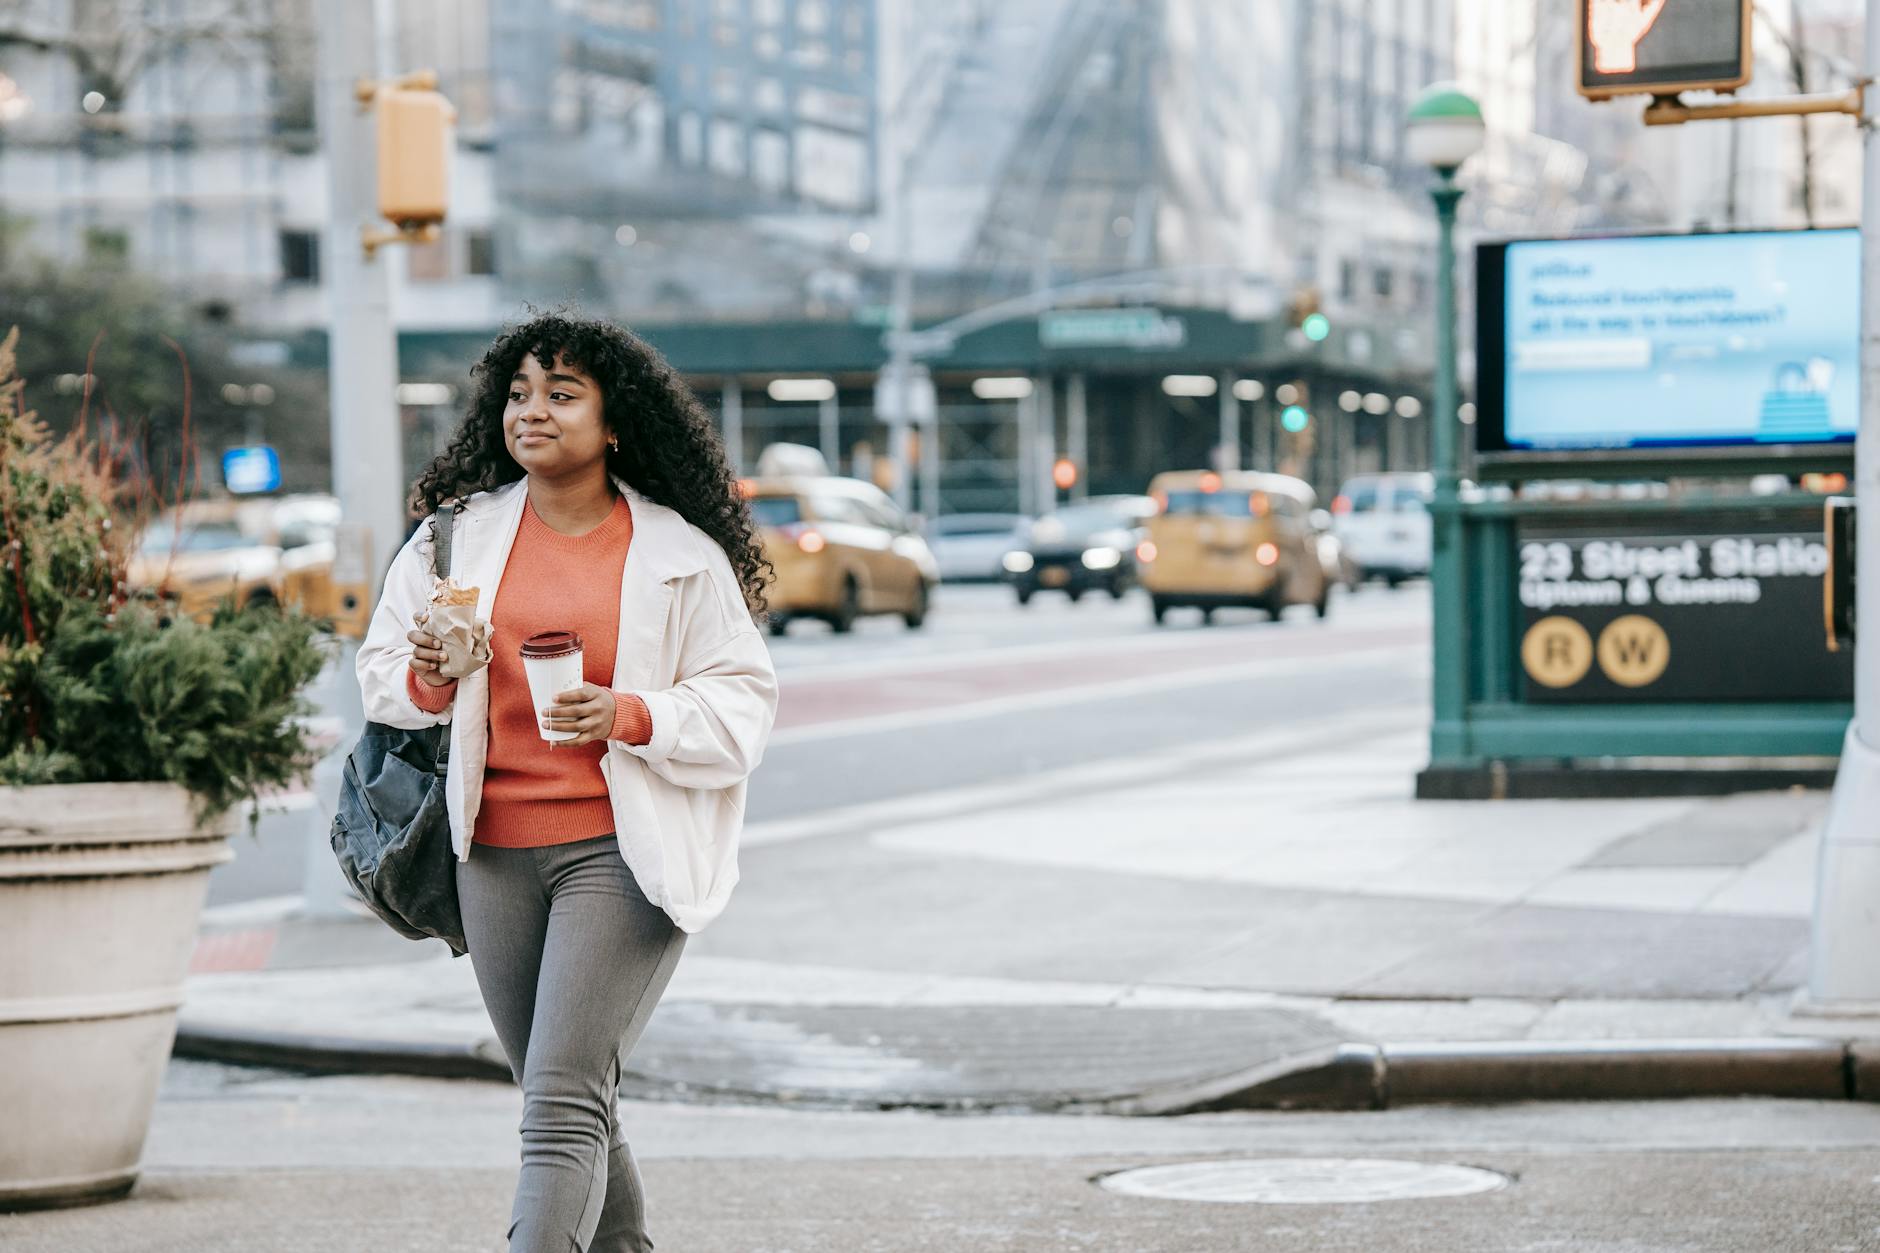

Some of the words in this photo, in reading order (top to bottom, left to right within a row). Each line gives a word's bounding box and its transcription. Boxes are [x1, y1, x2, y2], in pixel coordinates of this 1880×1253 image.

[1520, 542, 1573, 581] 23
[1581, 539, 1700, 579] Street
[1710, 536, 1828, 578] Statio
[1519, 578, 1623, 610] Uptown
[1625, 575, 1650, 605] &
[1654, 574, 1761, 605] Queens
[1542, 634, 1574, 668] R
[1612, 633, 1656, 666] W
